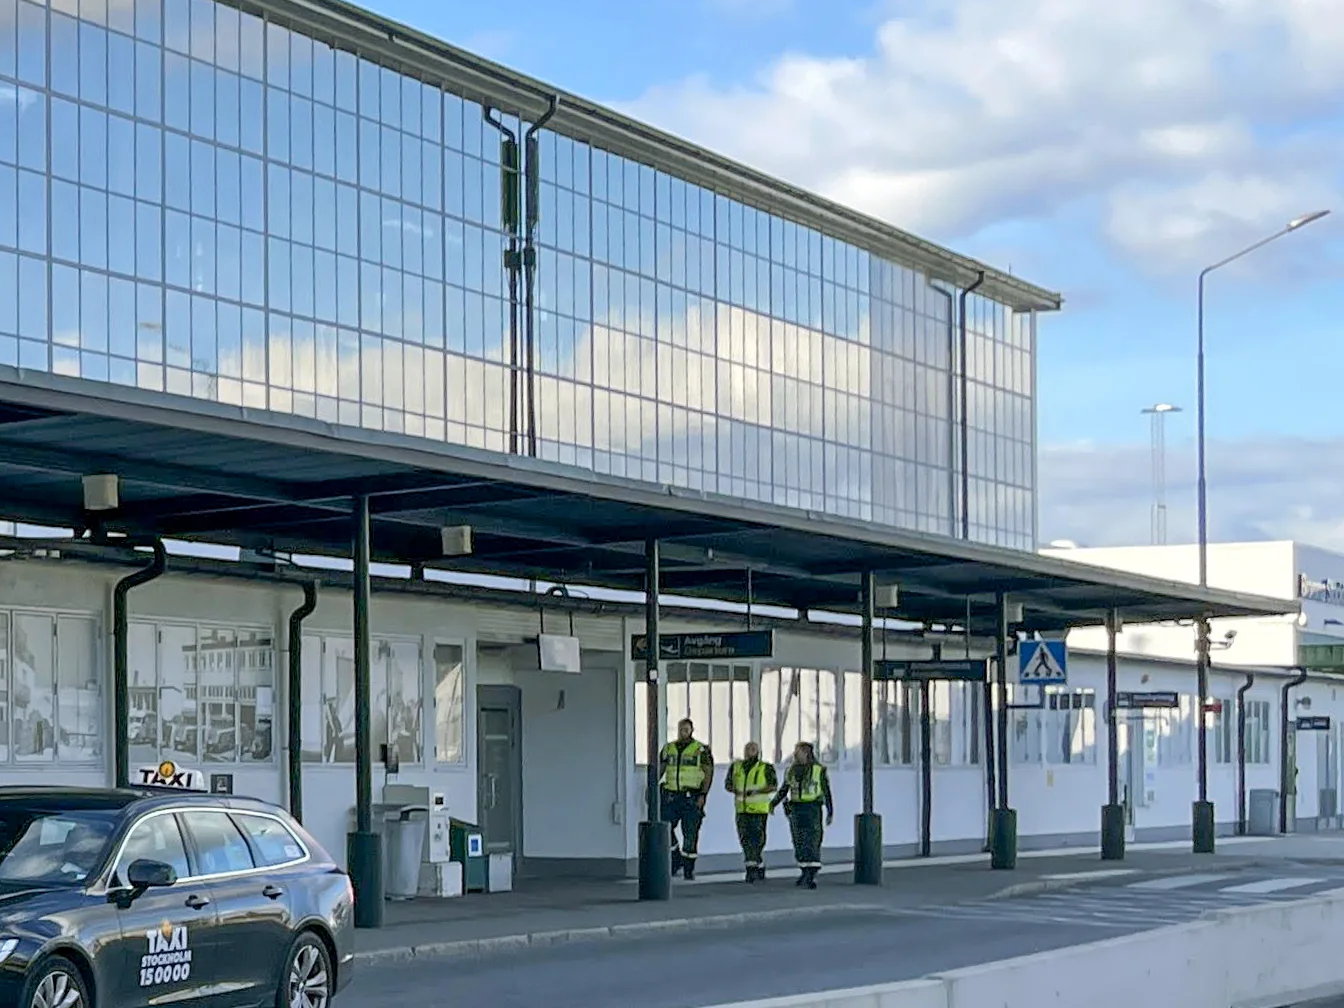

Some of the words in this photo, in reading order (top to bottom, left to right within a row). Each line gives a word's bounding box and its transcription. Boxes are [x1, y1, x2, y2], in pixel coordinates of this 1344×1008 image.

[139, 769, 192, 788] TAXI
[146, 926, 188, 954] TAXI
[141, 950, 192, 968] STOCKHOLM
